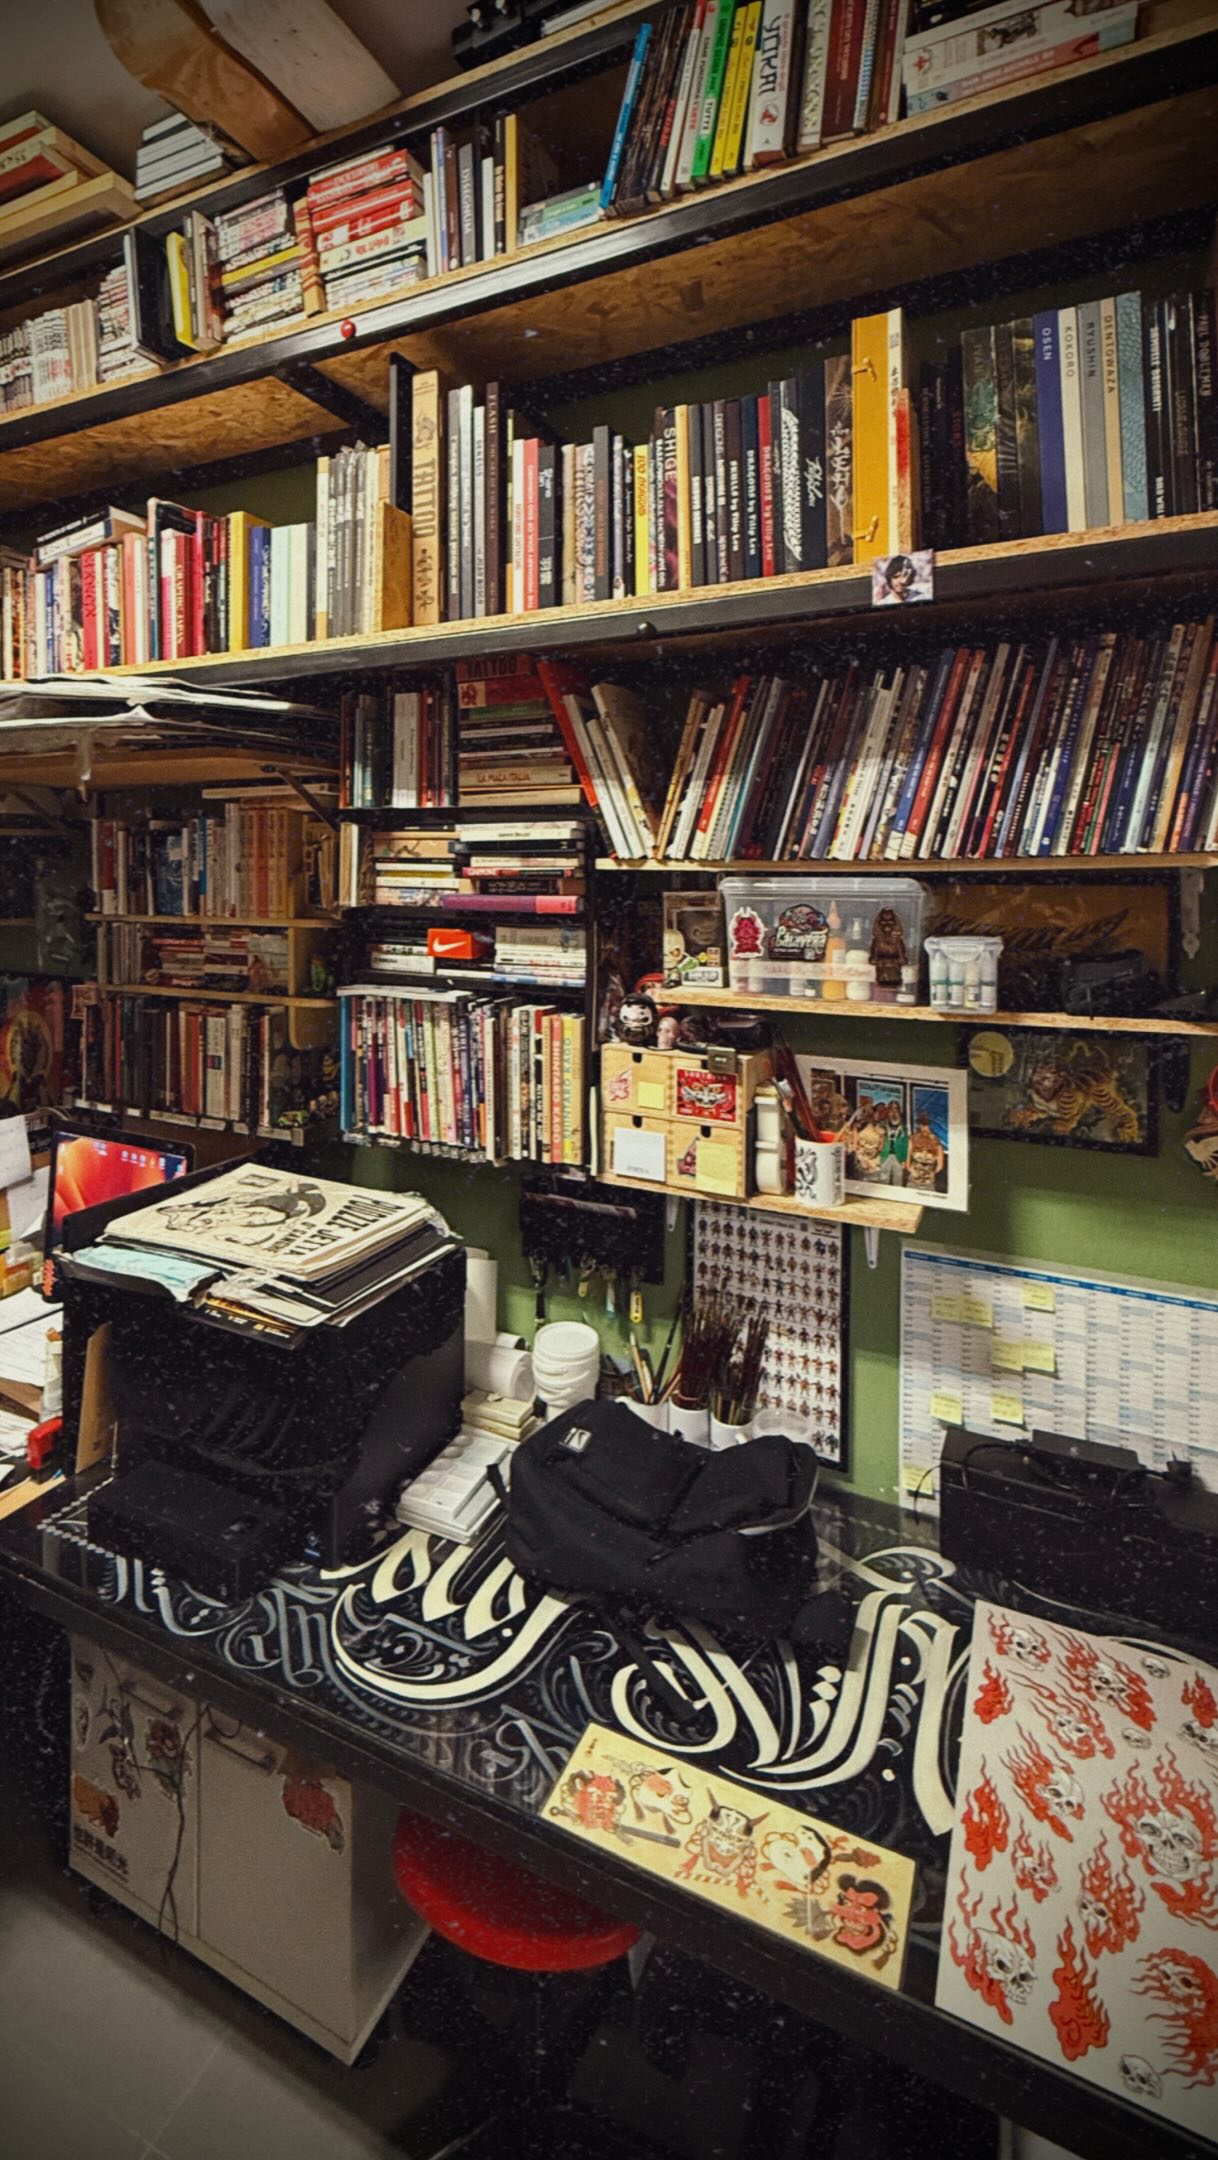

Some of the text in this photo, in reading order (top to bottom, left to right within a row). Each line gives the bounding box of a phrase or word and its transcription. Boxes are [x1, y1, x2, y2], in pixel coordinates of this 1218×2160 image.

[1042, 327, 1053, 361] OSEN
[1064, 326, 1075, 378] KOKORO
[1086, 321, 1096, 379] RYUSHIN
[1103, 314, 1116, 394] DENTOWAZA
[488, 394, 498, 434] FLASH
[663, 427, 678, 483] SHIGE
[552, 1039, 560, 1144] SHINTARO KAGO
